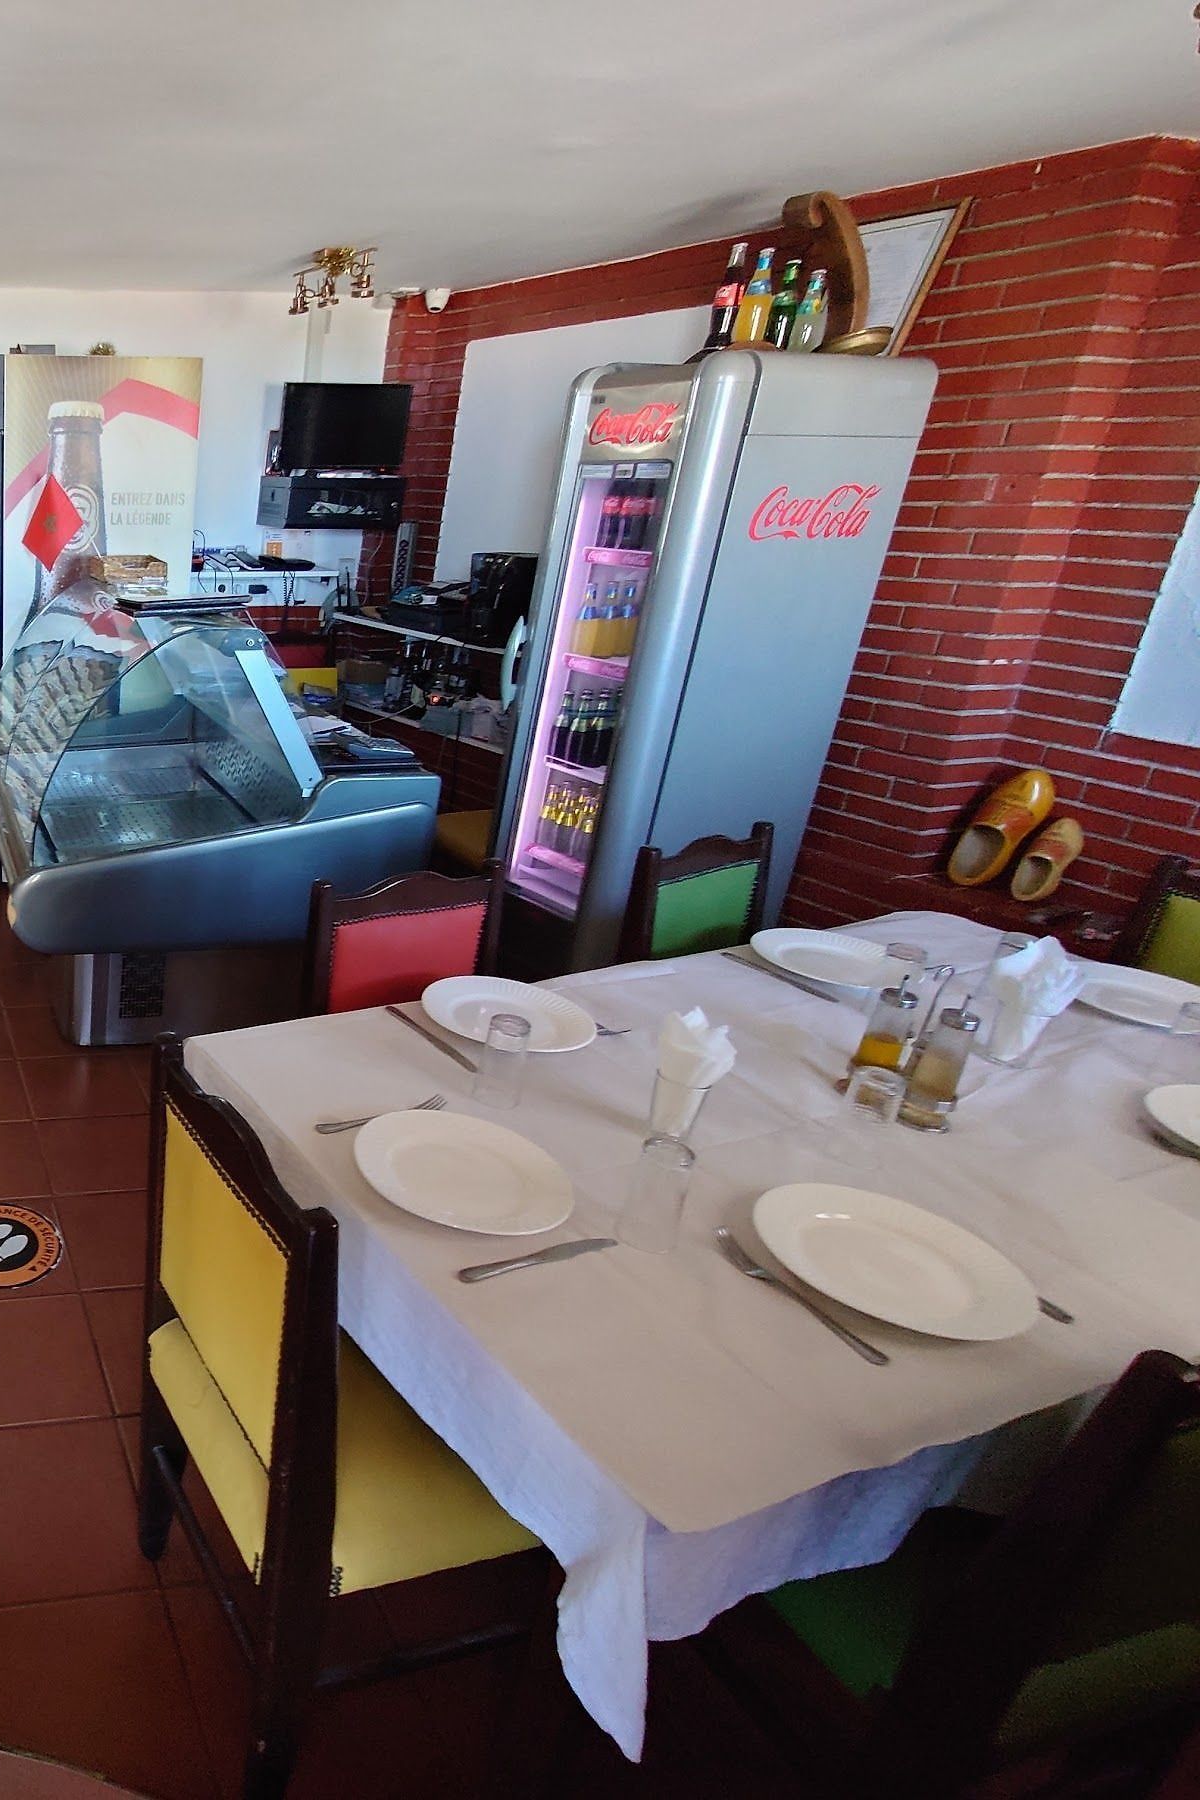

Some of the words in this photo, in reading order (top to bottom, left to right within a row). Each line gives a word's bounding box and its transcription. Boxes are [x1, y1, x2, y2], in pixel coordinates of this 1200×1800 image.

[111, 492, 153, 506] ENTREZ
[155, 492, 185, 506] DANS
[110, 512, 123, 526] LA
[126, 509, 171, 526] LÉGENDE
[29, 1216, 43, 1227] DE
